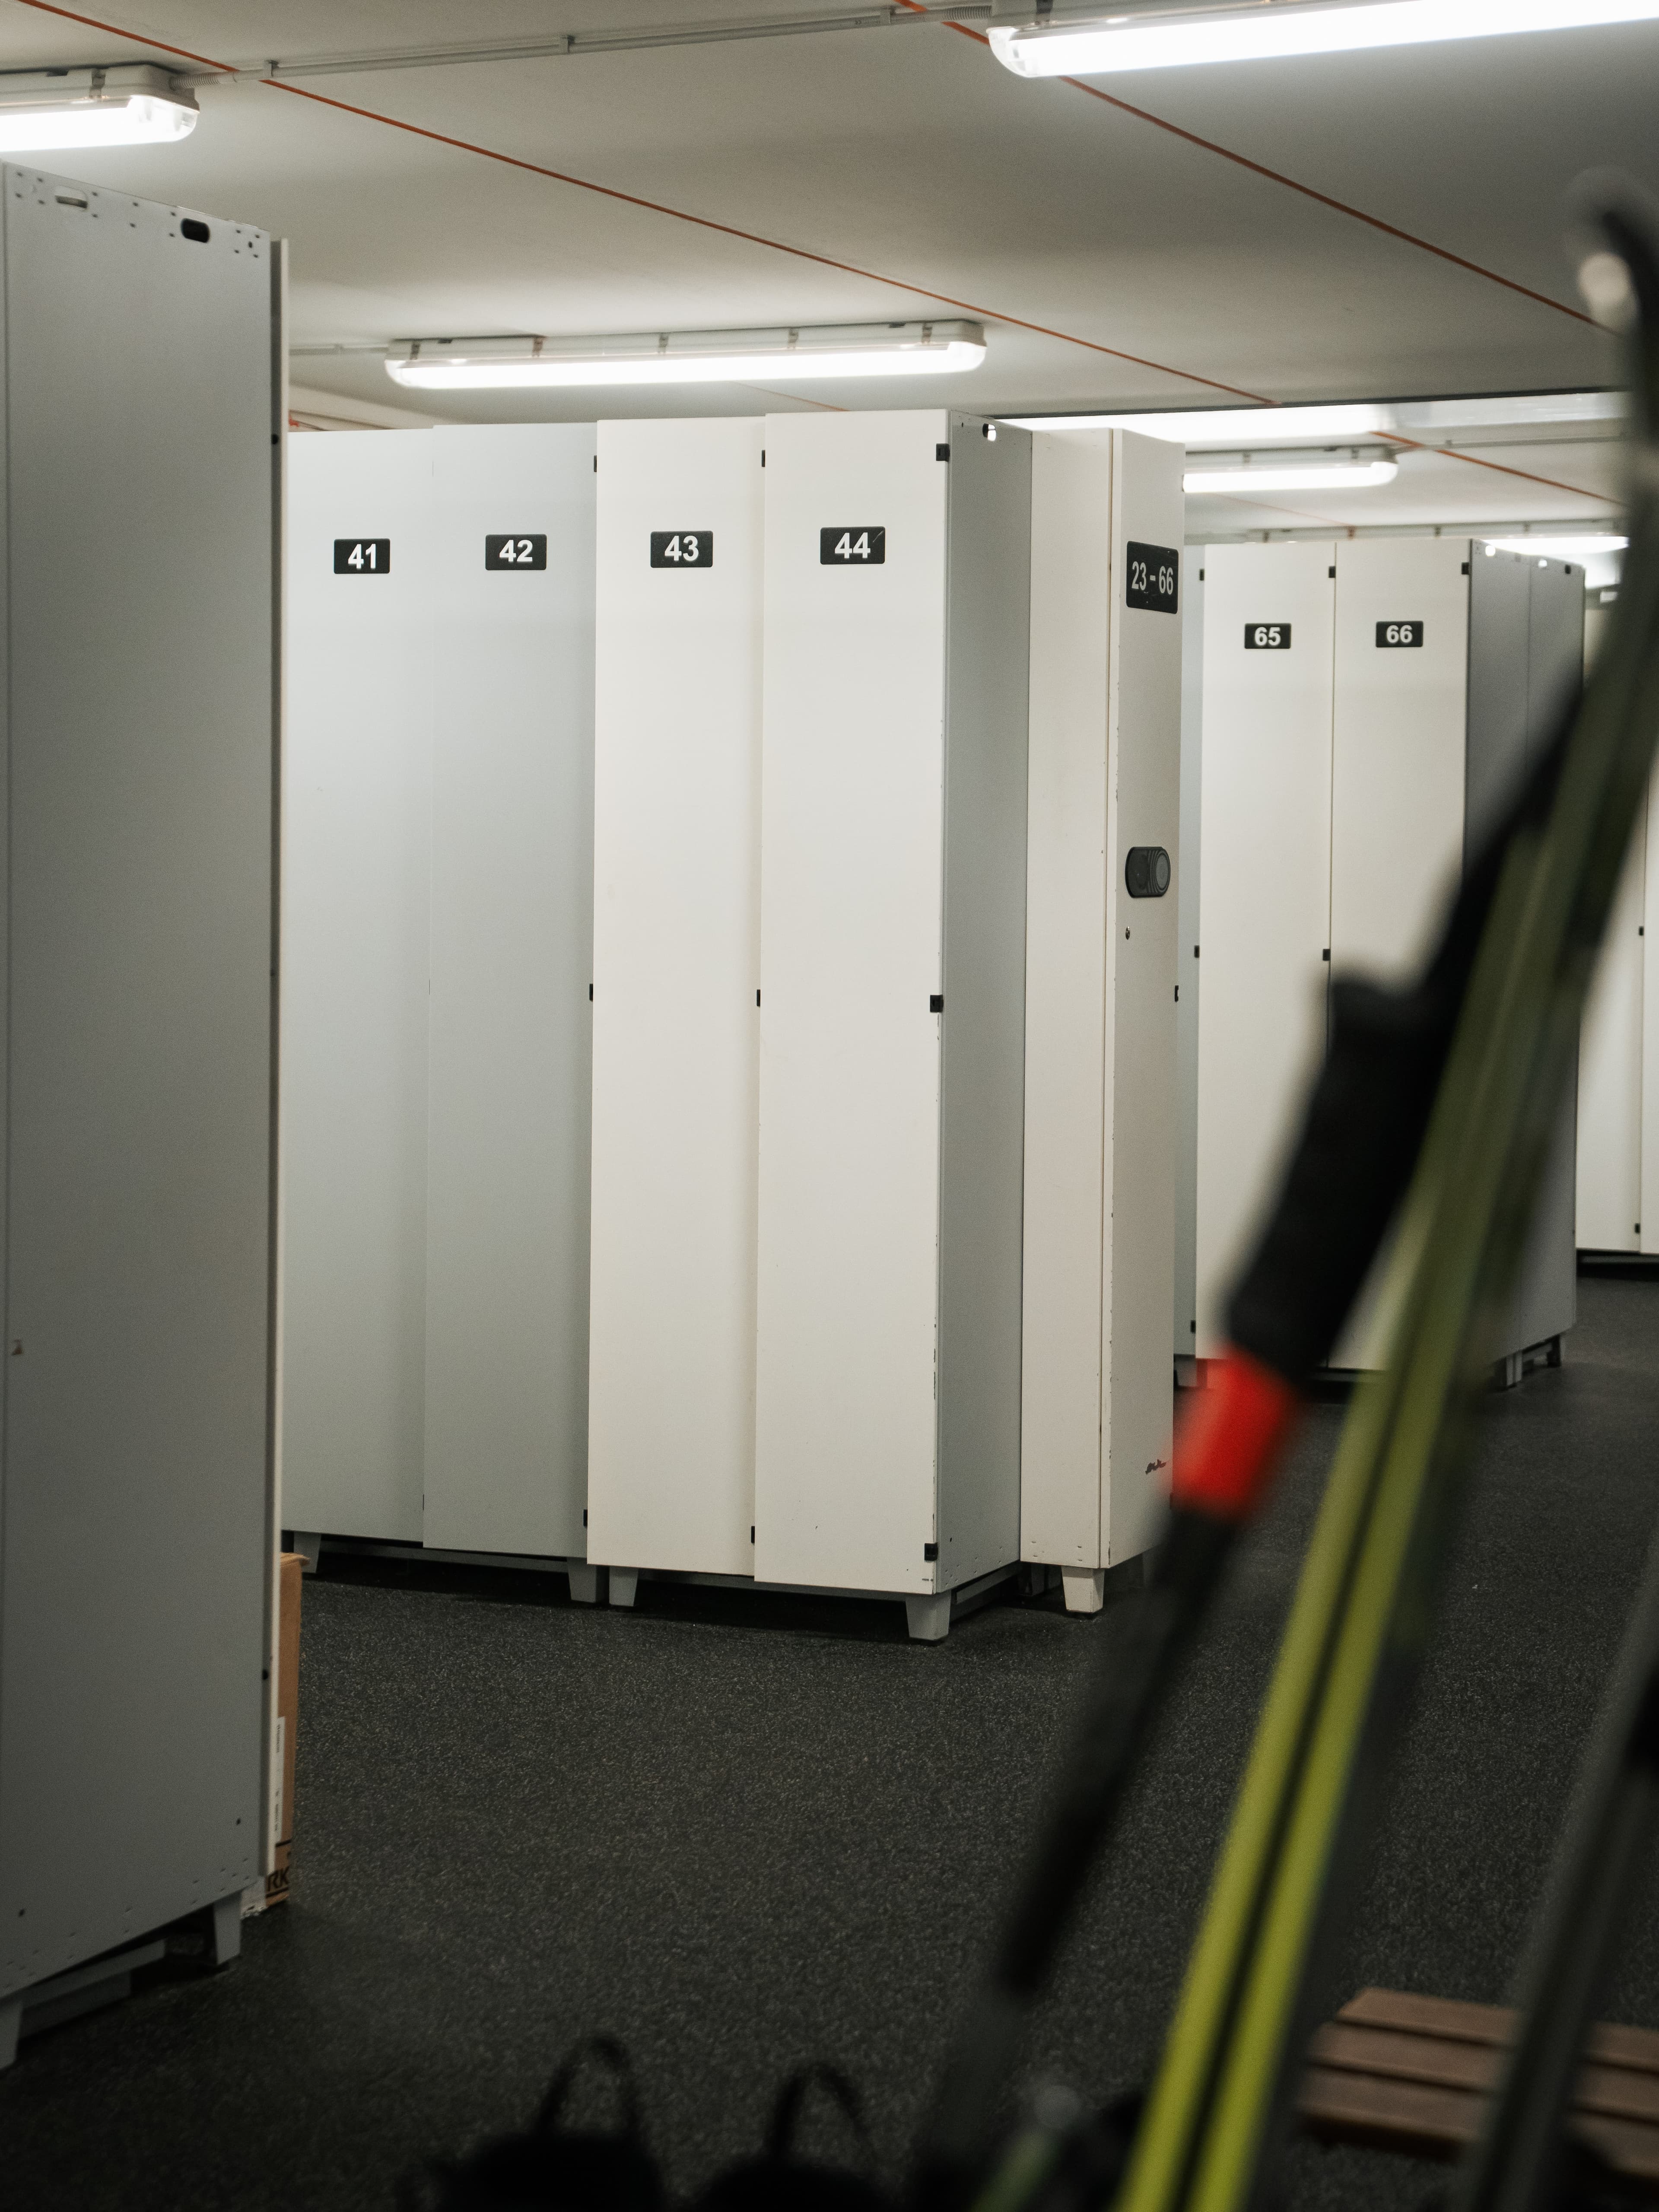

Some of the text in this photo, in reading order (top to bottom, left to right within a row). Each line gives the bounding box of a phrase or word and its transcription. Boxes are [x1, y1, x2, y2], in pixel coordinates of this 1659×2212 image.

[348, 543, 376, 569] 41
[499, 539, 533, 563] 42
[664, 535, 699, 562] 43
[834, 532, 871, 559] 44
[1254, 626, 1281, 646] 65
[1386, 625, 1413, 644] 66
